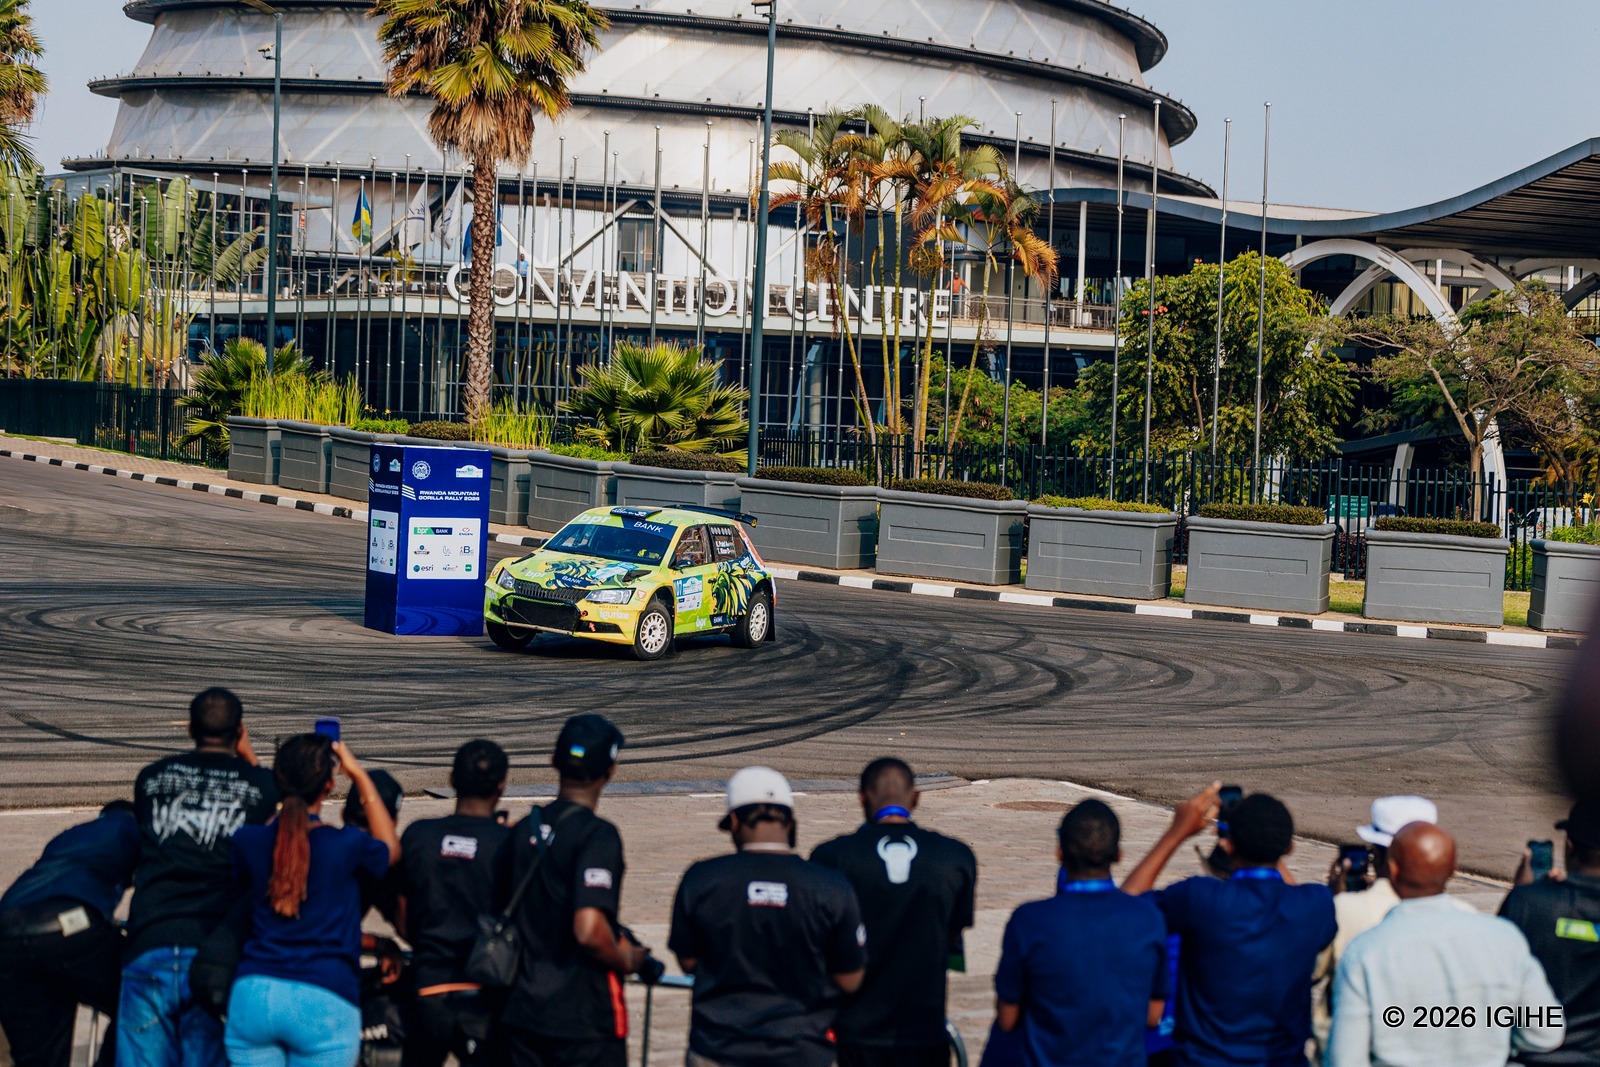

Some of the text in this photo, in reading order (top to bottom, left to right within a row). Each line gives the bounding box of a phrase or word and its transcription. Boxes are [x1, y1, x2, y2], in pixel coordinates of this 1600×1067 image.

[446, 262, 950, 328] CONVENTION CENTRE
[578, 513, 612, 524] bpr
[633, 521, 664, 533] BANK
[421, 564, 434, 572] esri
[561, 575, 583, 584] BANK
